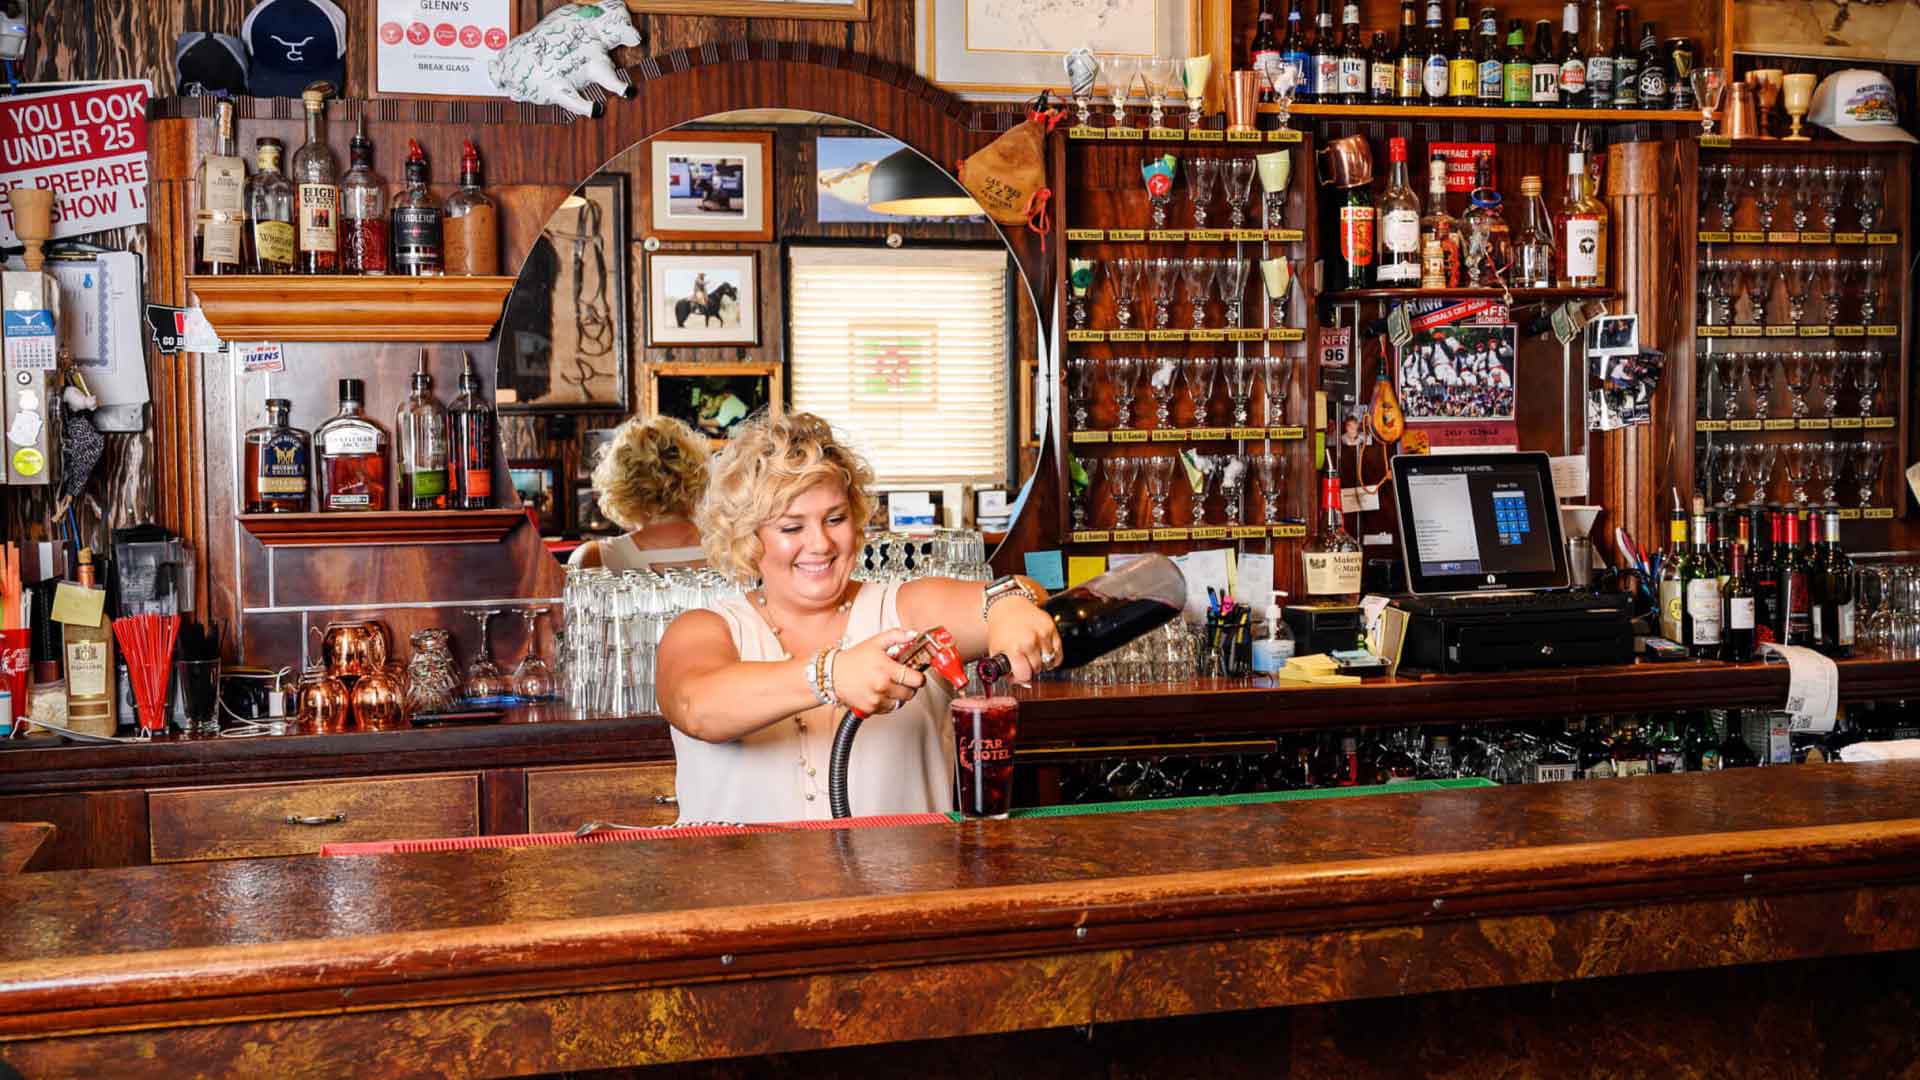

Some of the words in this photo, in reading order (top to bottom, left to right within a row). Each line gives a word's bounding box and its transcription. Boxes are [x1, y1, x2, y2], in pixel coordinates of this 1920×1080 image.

[420, 0, 469, 12] GLENN'S
[418, 63, 444, 72] BREAK
[445, 64, 470, 73] GLASS
[1343, 61, 1360, 74] Lite
[8, 102, 63, 135] YOU
[69, 91, 146, 127] LOOK
[2, 128, 93, 167] UNDER
[100, 122, 136, 152] 25
[34, 160, 148, 196] PREPARE
[303, 187, 336, 198] HIGH
[303, 197, 336, 205] WEST
[51, 191, 118, 225] SHOW
[162, 336, 175, 346] GO
[1321, 335, 1349, 345] NFR
[1324, 348, 1345, 361] 96
[968, 738, 1003, 750] STAR
[974, 749, 1009, 761] HOTEL
[1542, 768, 1566, 780] KNOB
